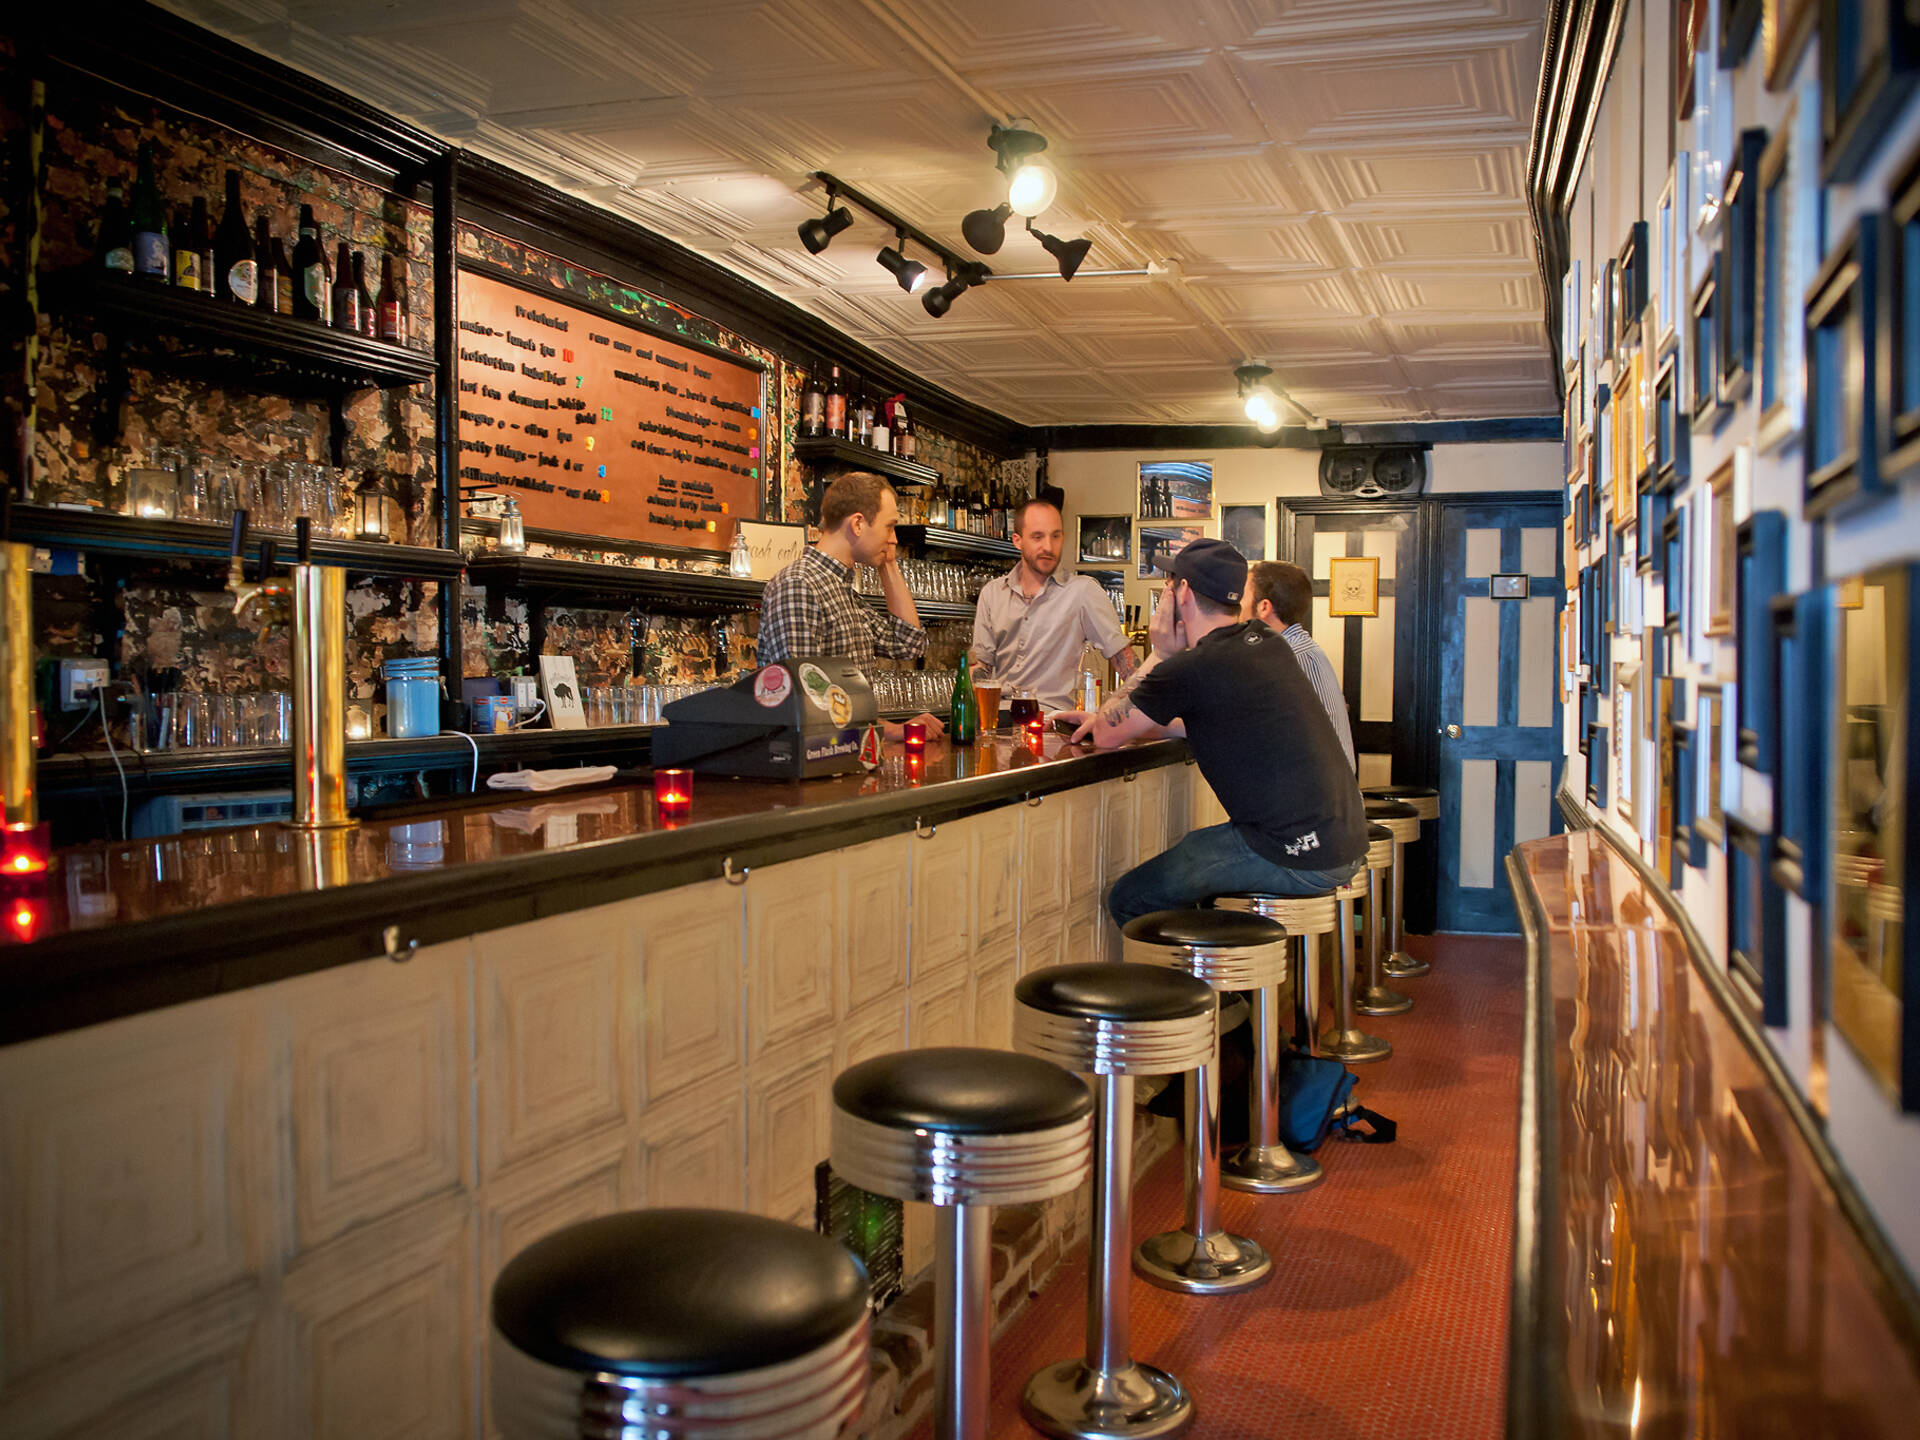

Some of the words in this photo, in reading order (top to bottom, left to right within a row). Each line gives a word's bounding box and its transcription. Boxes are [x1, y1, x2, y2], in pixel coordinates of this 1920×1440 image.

[506, 331, 536, 351] lunch
[540, 343, 555, 358] ipa
[562, 348, 574, 363] 10
[636, 348, 653, 360] and
[575, 376, 584, 389] 7
[601, 406, 613, 421] 12
[557, 428, 573, 444] ipa
[585, 436, 595, 451] 9
[495, 444, 527, 463] things
